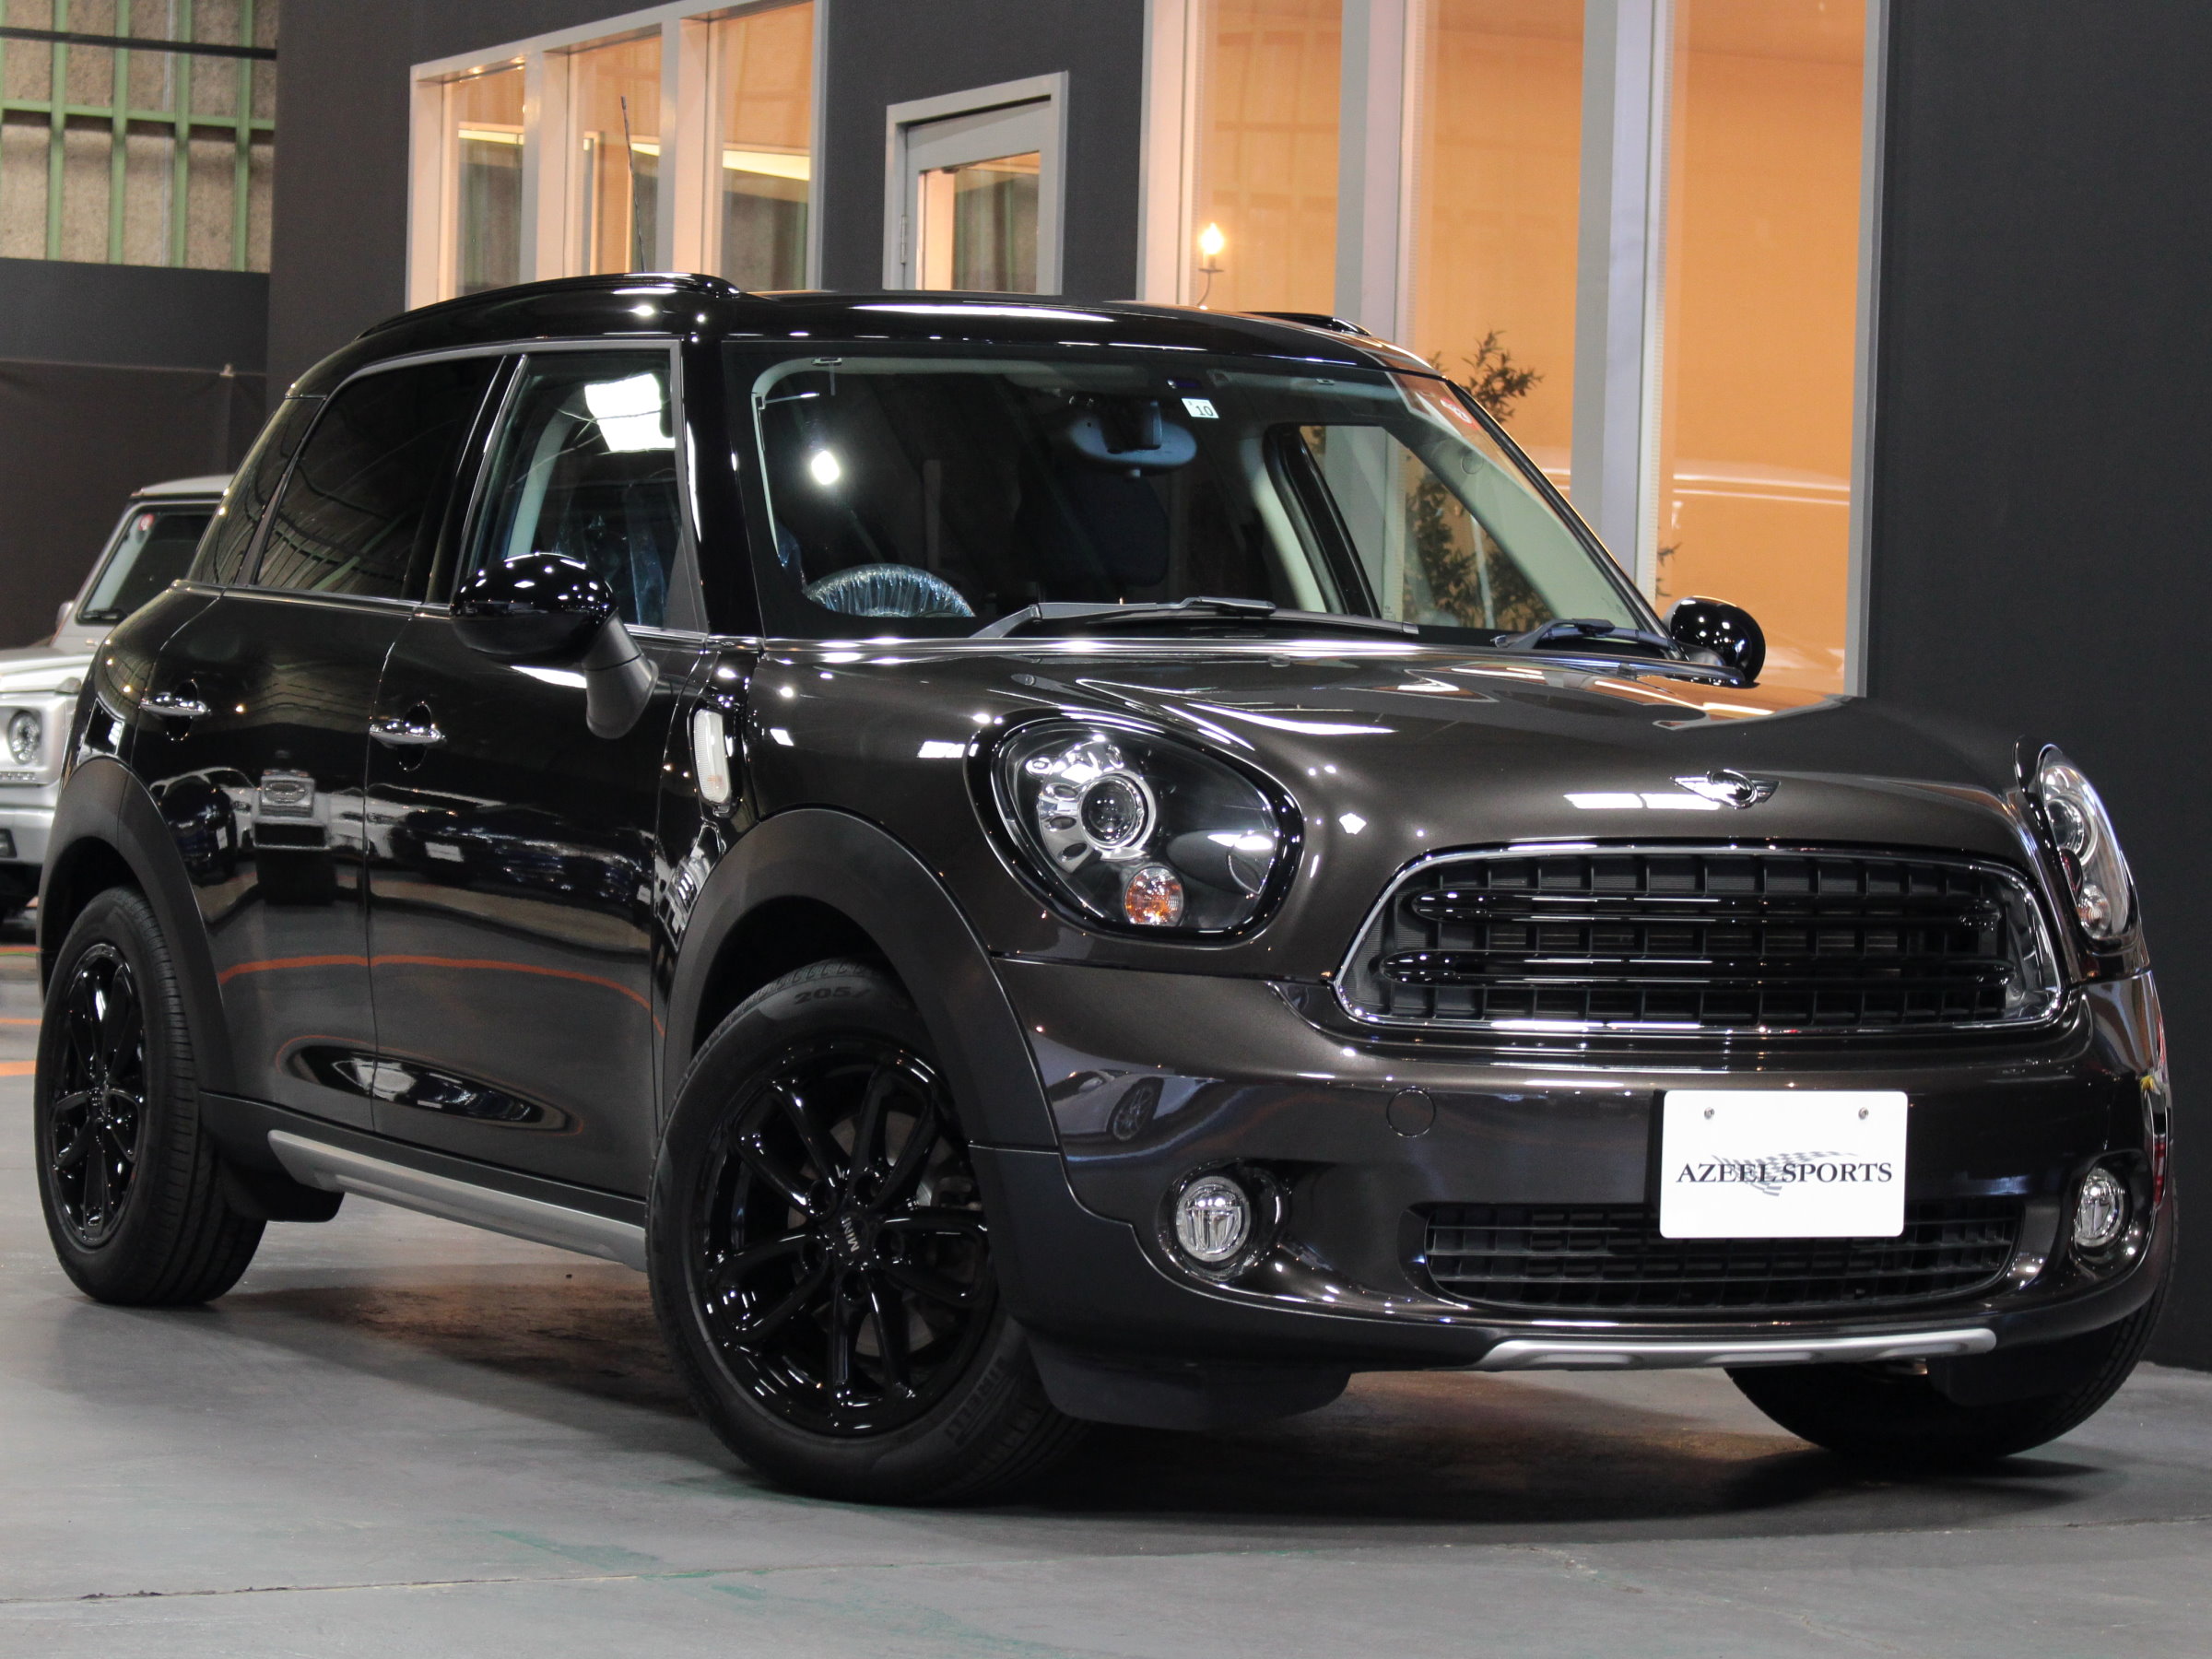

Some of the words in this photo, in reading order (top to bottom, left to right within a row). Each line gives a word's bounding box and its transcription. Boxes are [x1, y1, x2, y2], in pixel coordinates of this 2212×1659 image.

[1195, 406, 1214, 417] 10
[1676, 1162, 1779, 1182] AZEEL
[1781, 1162, 1892, 1182] SPORTS
[841, 1217, 860, 1253] MINI
